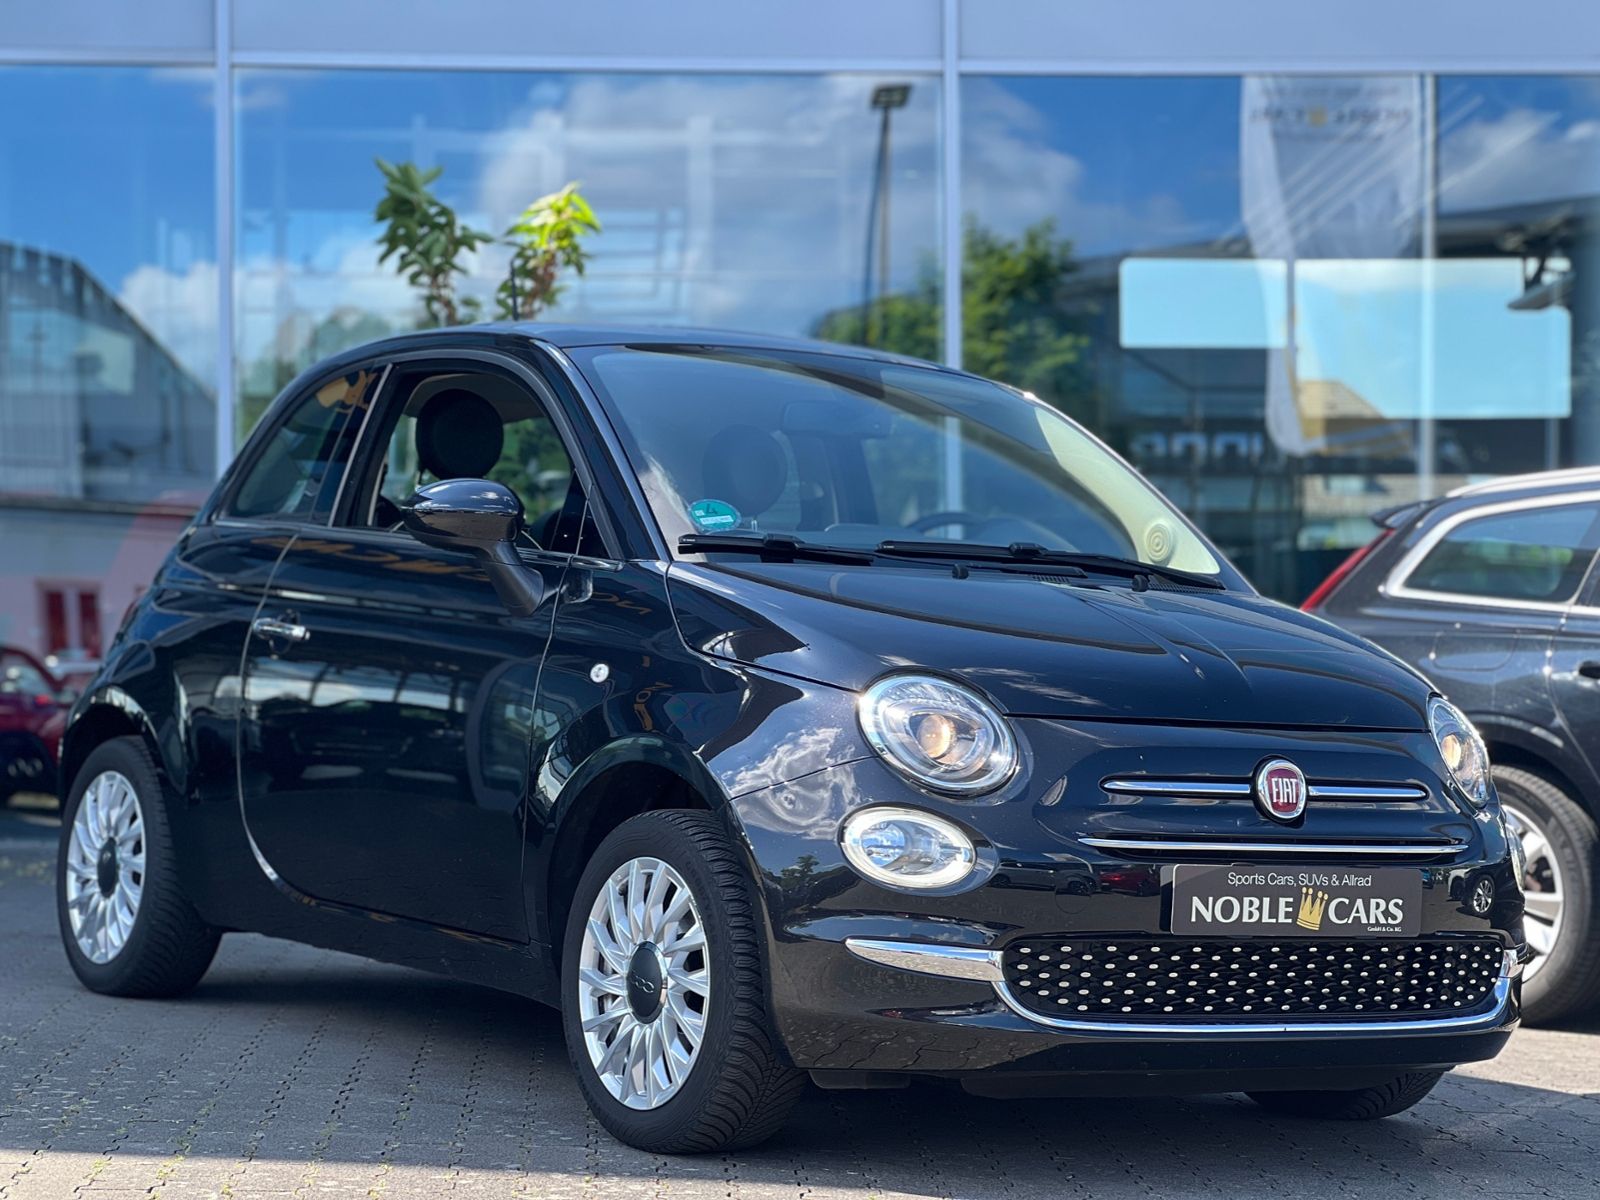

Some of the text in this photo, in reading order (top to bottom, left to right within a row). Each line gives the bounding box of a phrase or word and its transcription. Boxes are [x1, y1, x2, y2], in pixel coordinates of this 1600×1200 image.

[1271, 777, 1298, 804] FIAT
[1227, 871, 1372, 887] Sports Cars, SUVs & Allrad
[1190, 895, 1404, 925] NOBLE CARS
